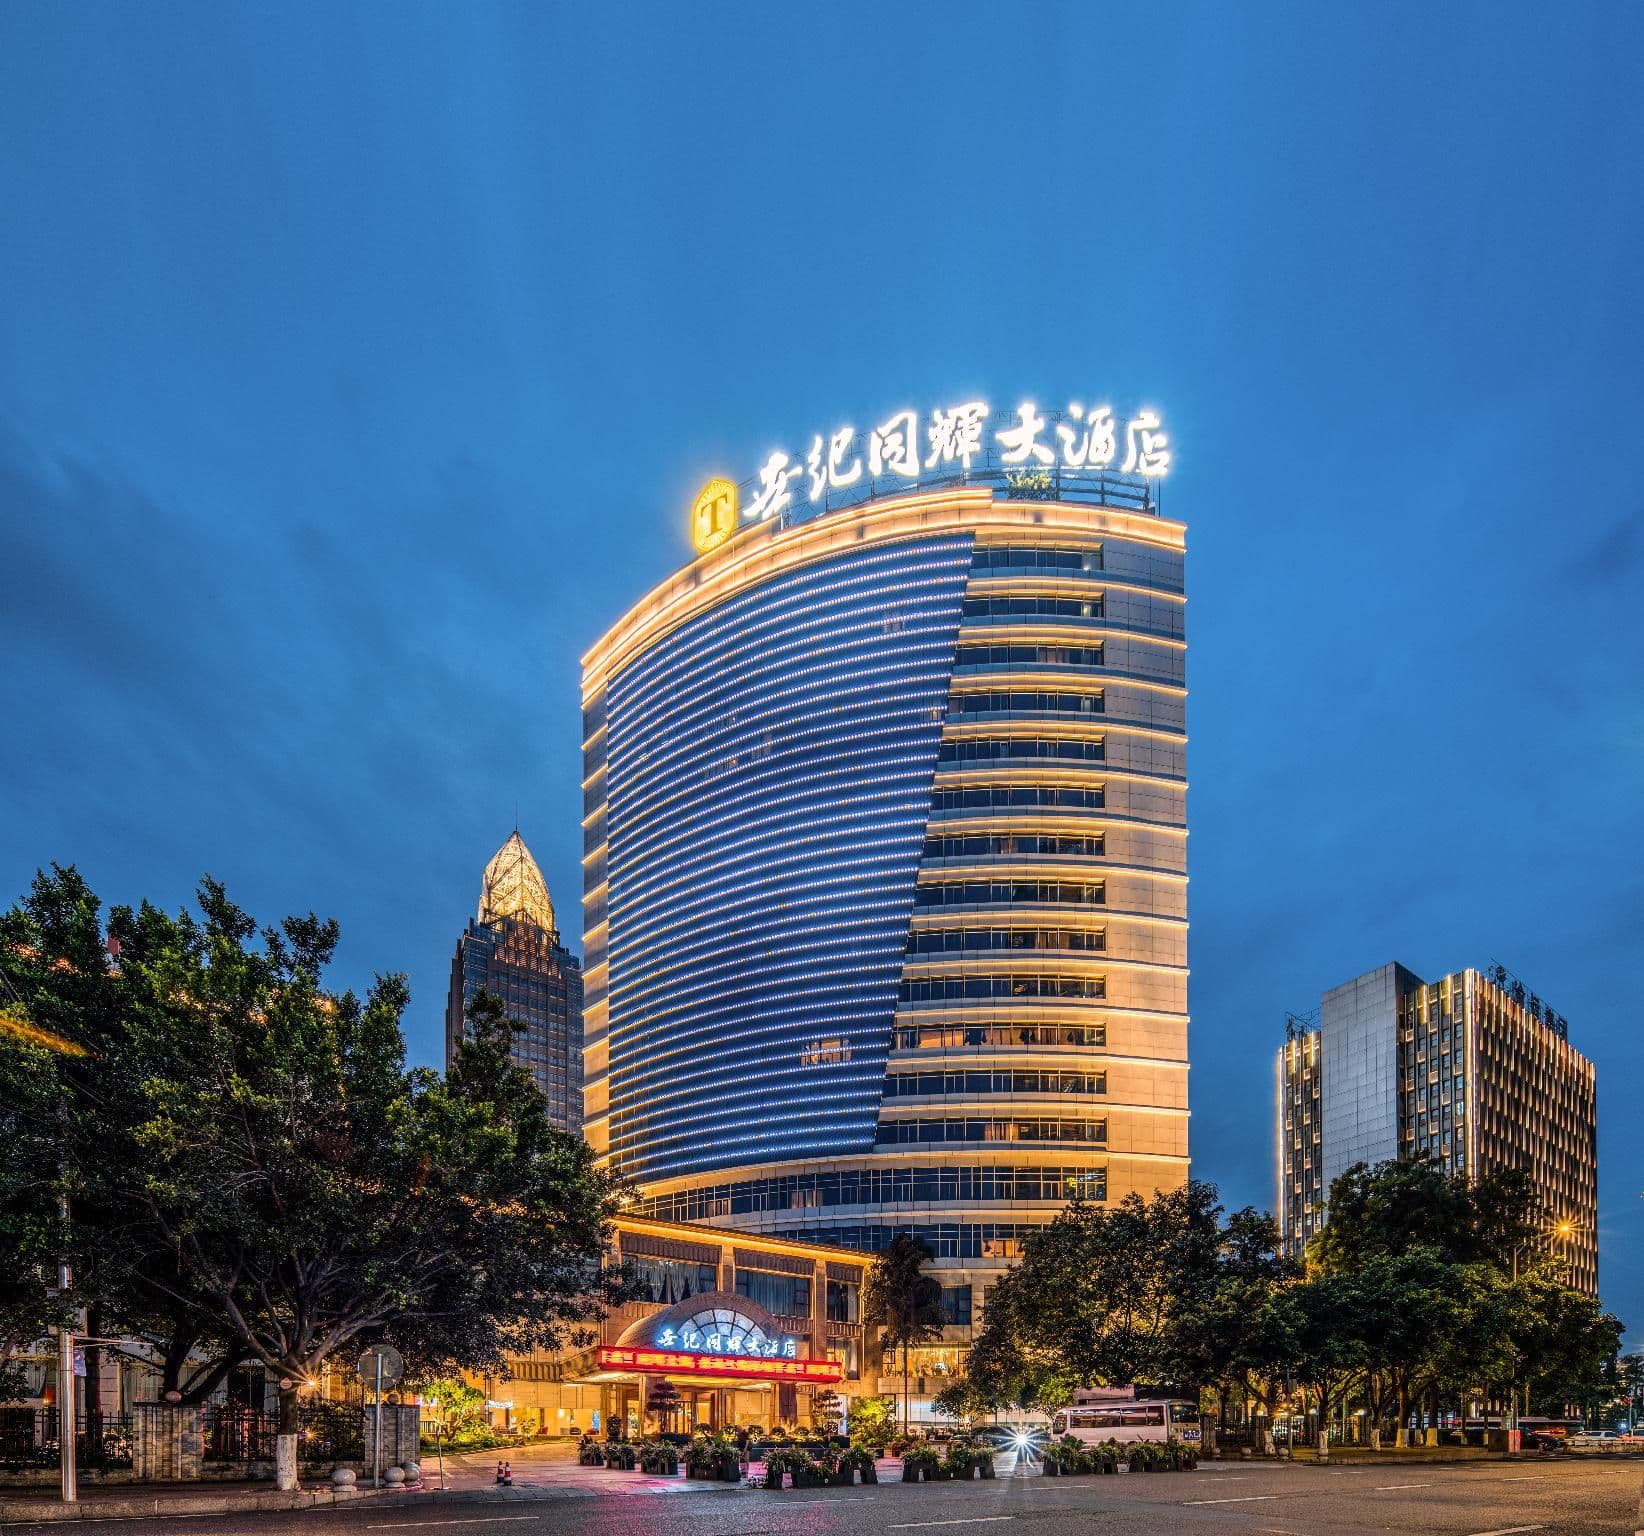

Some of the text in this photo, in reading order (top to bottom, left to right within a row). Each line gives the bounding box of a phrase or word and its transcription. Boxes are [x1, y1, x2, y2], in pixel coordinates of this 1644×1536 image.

[742, 401, 1170, 518] 世纪同辉大酒店
[700, 493, 728, 538] T
